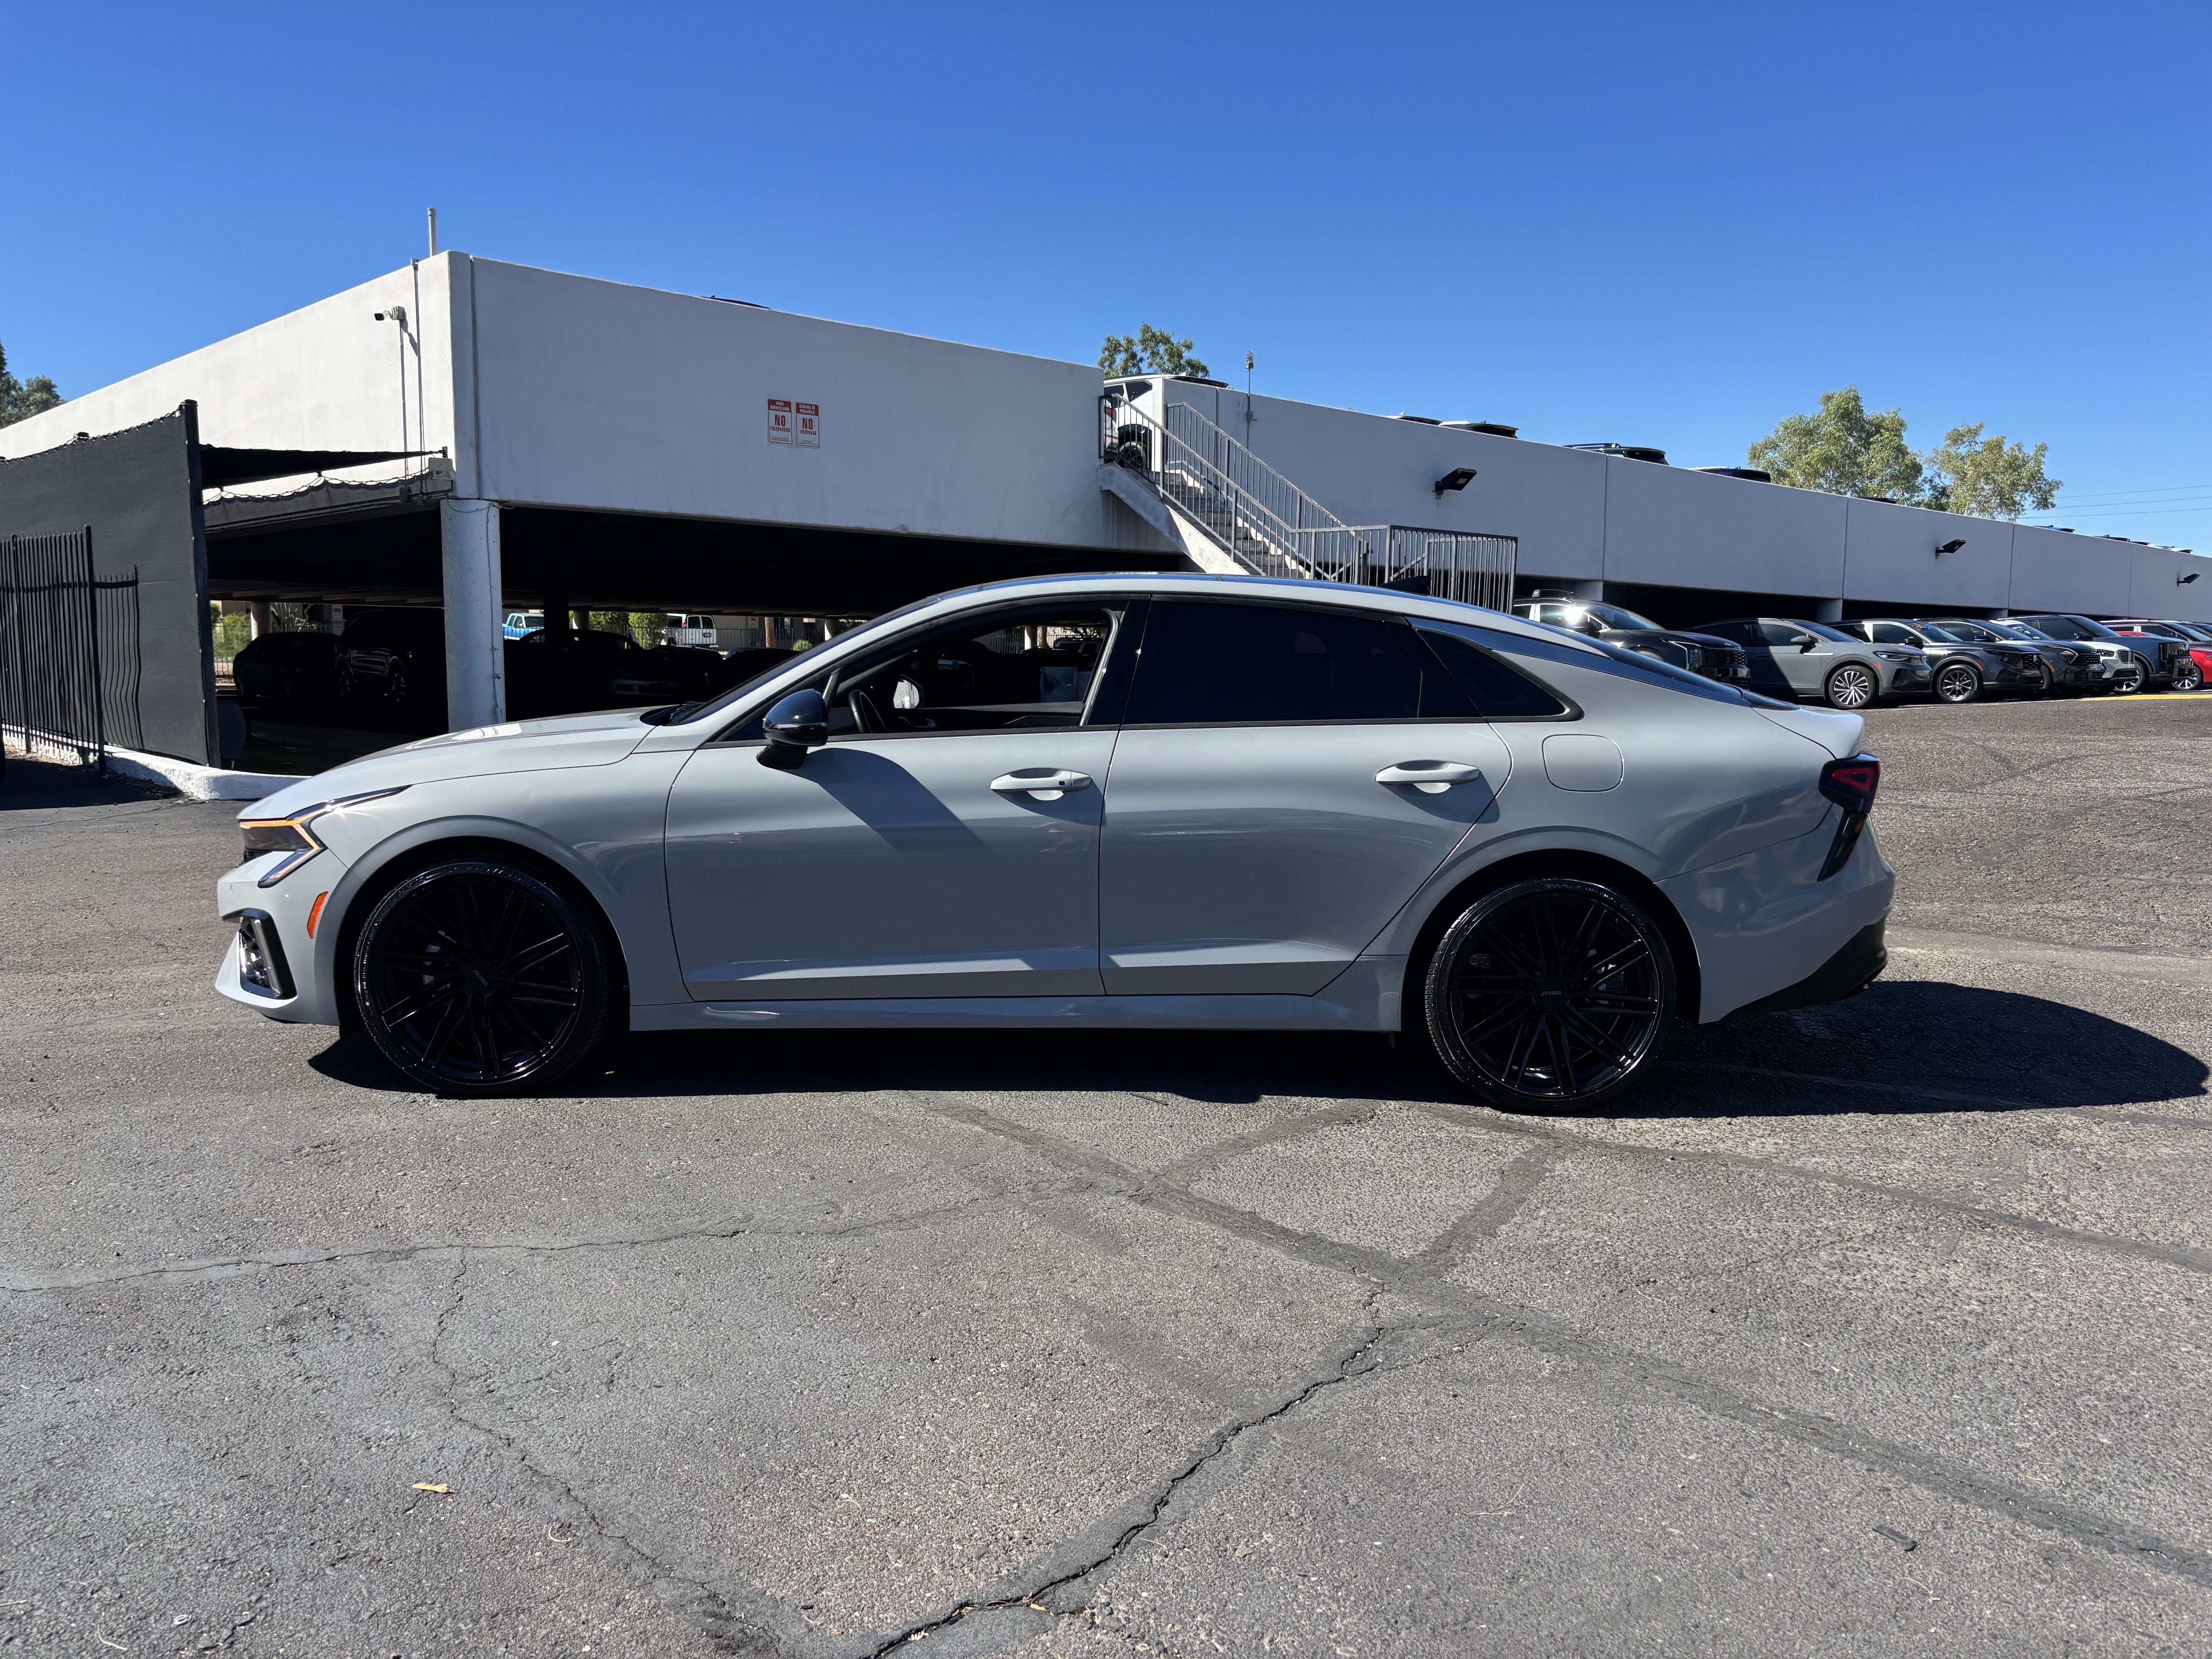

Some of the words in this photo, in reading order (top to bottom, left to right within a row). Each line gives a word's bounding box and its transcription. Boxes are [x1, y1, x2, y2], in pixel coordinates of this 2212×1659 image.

[775, 414, 786, 427] NO
[802, 418, 813, 430] NO
[471, 969, 489, 986] PETROL
